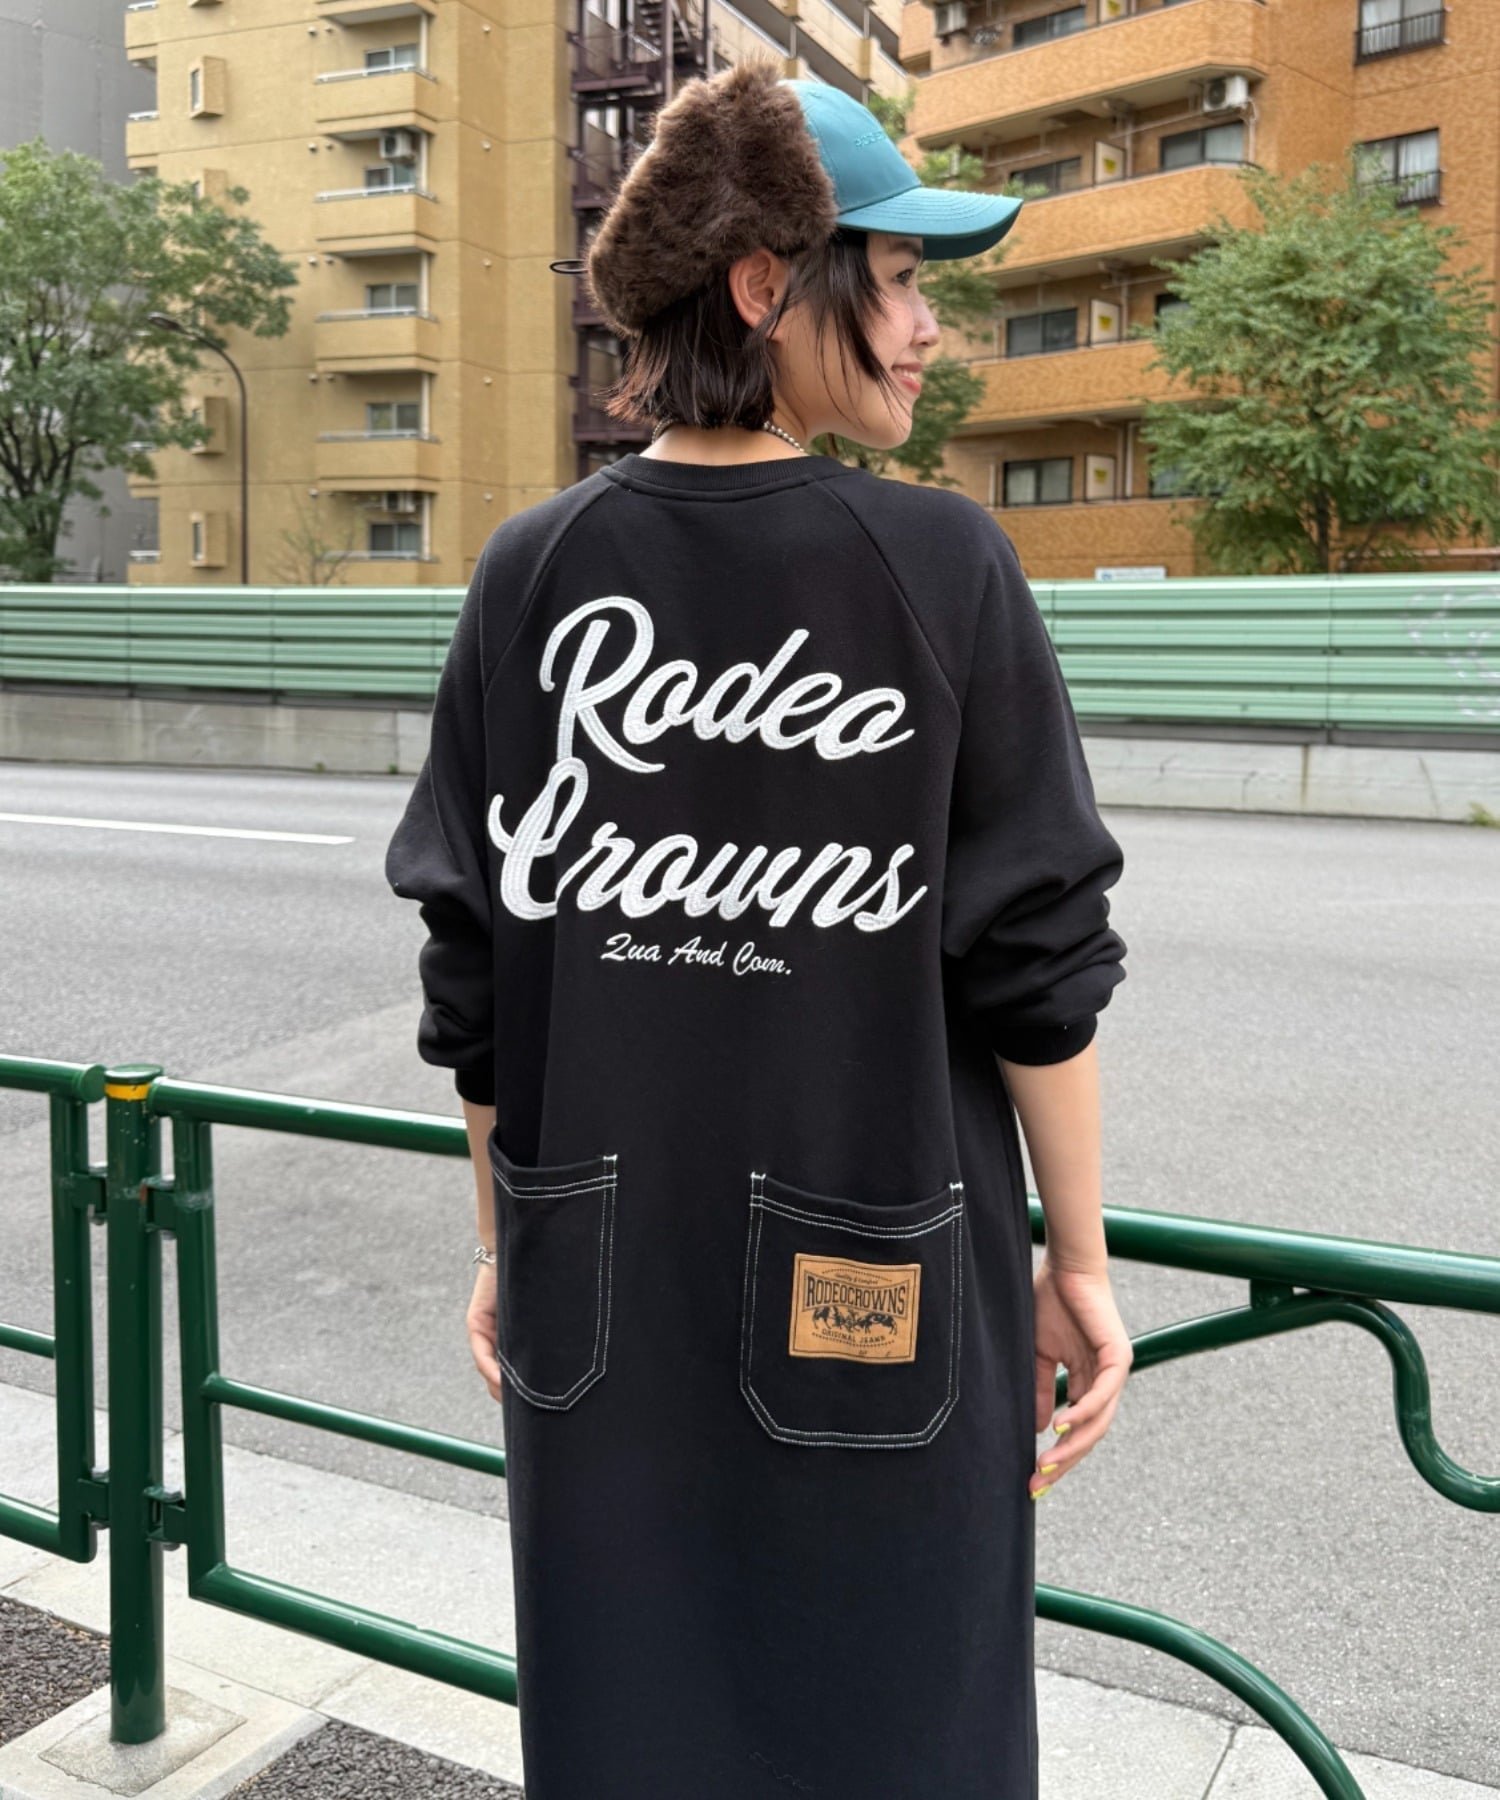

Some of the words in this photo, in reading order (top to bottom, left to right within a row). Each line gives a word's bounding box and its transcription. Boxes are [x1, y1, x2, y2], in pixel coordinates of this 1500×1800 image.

[539, 595, 914, 773] Rodeo
[488, 757, 928, 933] Crowns
[667, 935, 728, 966] And
[732, 941, 792, 976] Com.
[806, 1276, 906, 1315] RODEOCROWNS
